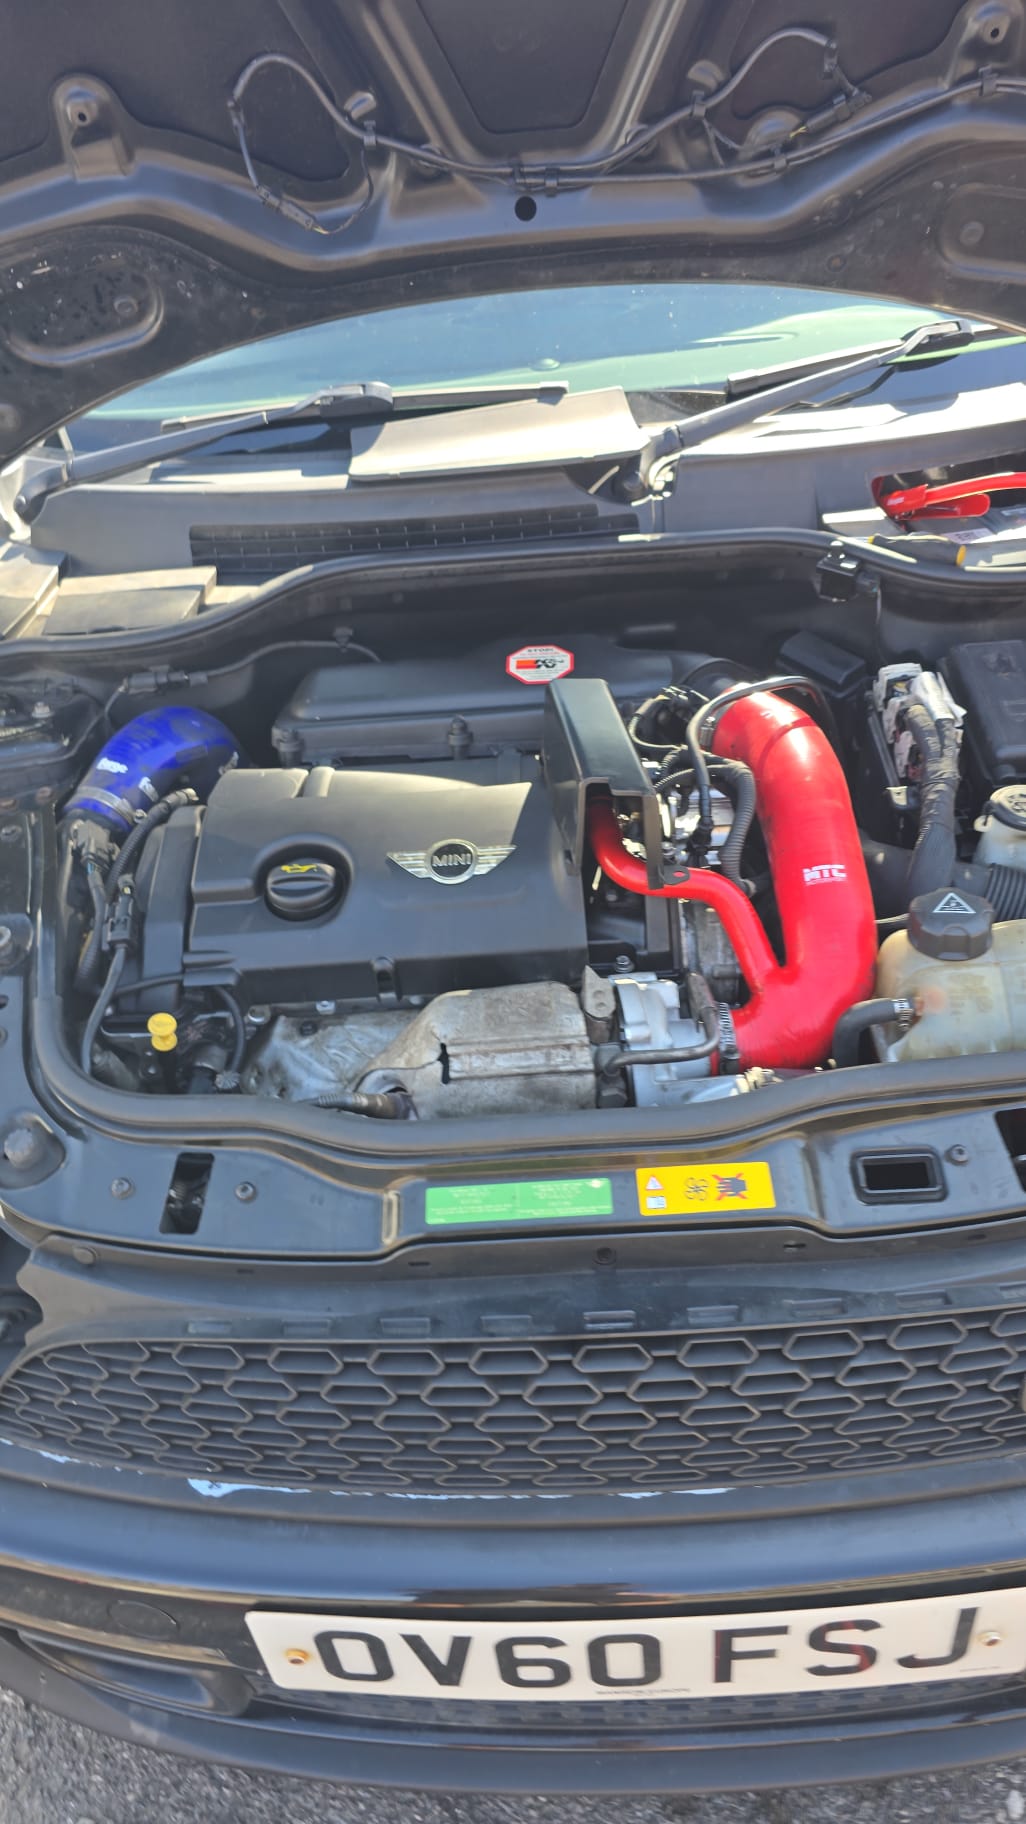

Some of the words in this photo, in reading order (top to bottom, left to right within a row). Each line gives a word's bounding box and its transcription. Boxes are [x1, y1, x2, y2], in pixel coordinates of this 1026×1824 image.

[432, 853, 472, 867] MINI
[802, 864, 847, 881] MTC
[313, 1630, 663, 1688] OV60
[713, 1606, 980, 1684] FSJ
